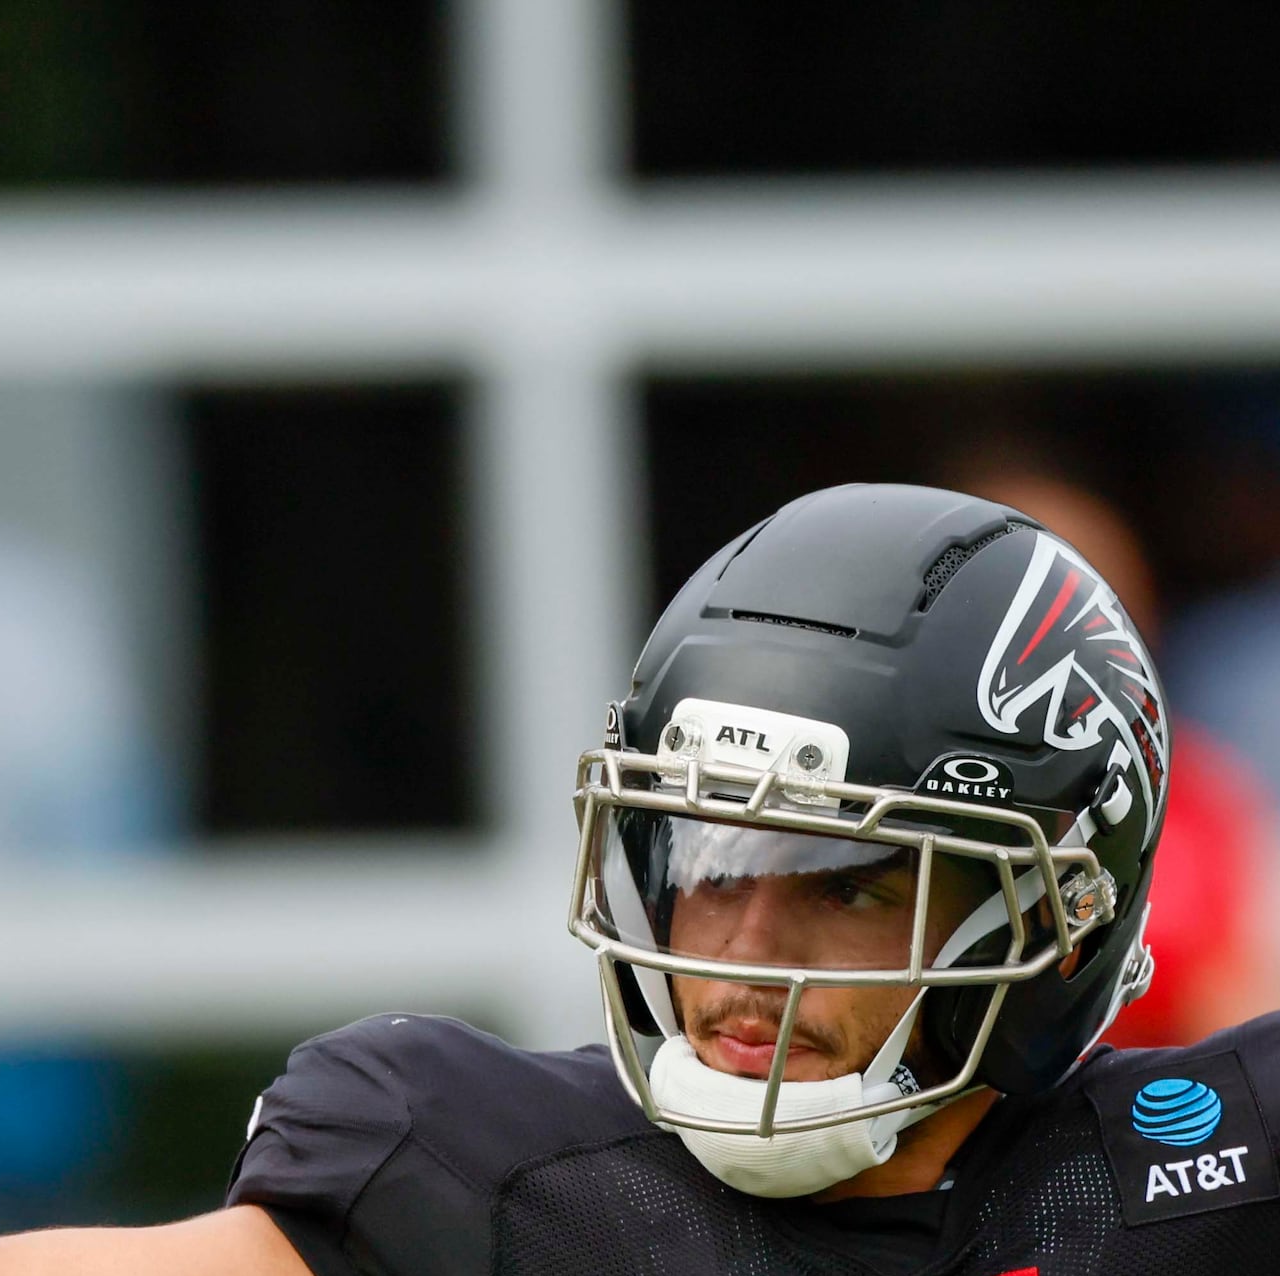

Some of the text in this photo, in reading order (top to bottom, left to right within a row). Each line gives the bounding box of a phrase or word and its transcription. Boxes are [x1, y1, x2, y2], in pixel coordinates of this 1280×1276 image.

[716, 725, 770, 752] ATL
[927, 779, 1010, 799] OAKLEY
[1145, 1146, 1248, 1202] AT&T
